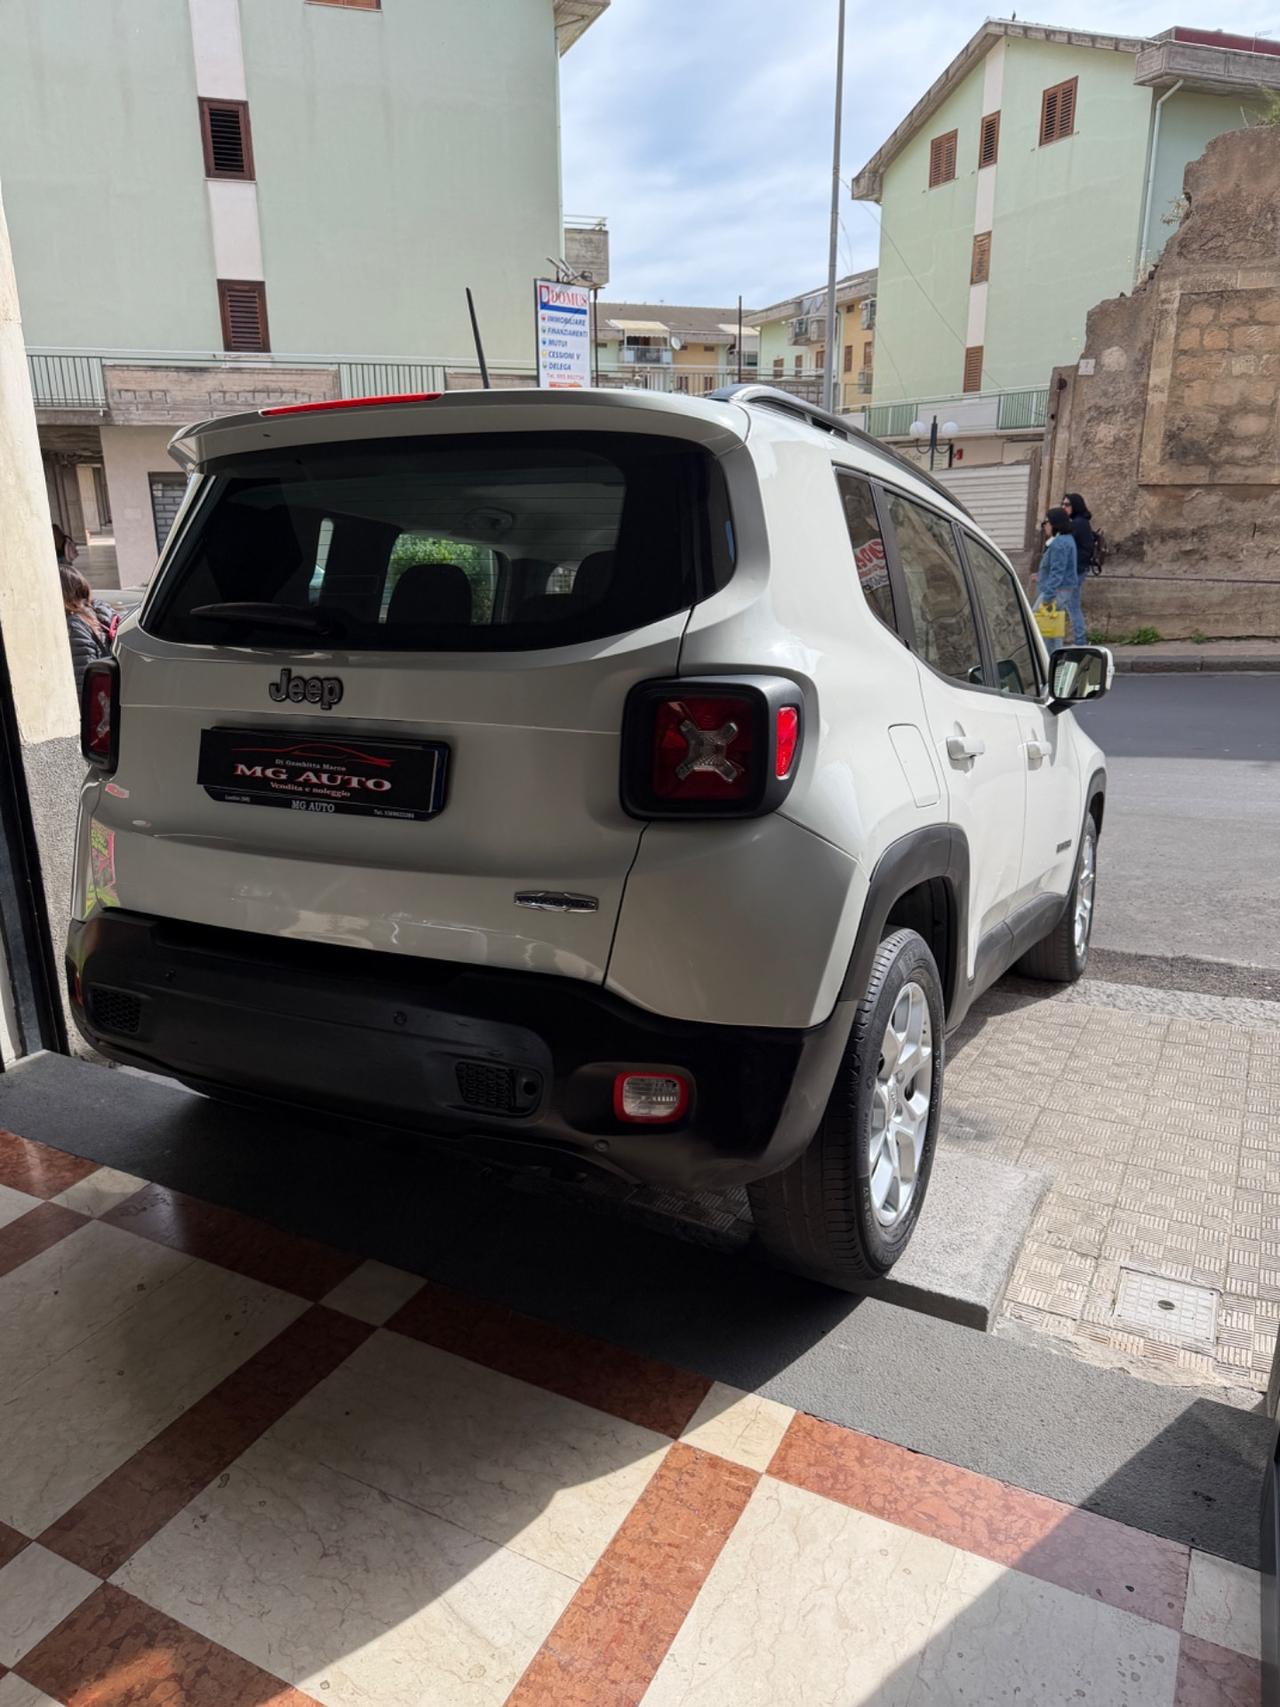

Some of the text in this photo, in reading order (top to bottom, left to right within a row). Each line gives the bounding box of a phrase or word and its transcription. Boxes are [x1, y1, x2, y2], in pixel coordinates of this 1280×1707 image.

[550, 290, 588, 307] DOMUS
[548, 339, 568, 348] MUTUI
[548, 351, 575, 361] CESSIONI
[548, 363, 571, 372] DELEGA
[269, 668, 343, 710] Jeep
[233, 763, 392, 792] MG AUTO
[269, 781, 303, 792] Vendita
[312, 787, 351, 798] noleggio
[290, 800, 336, 813] MG AUTO
